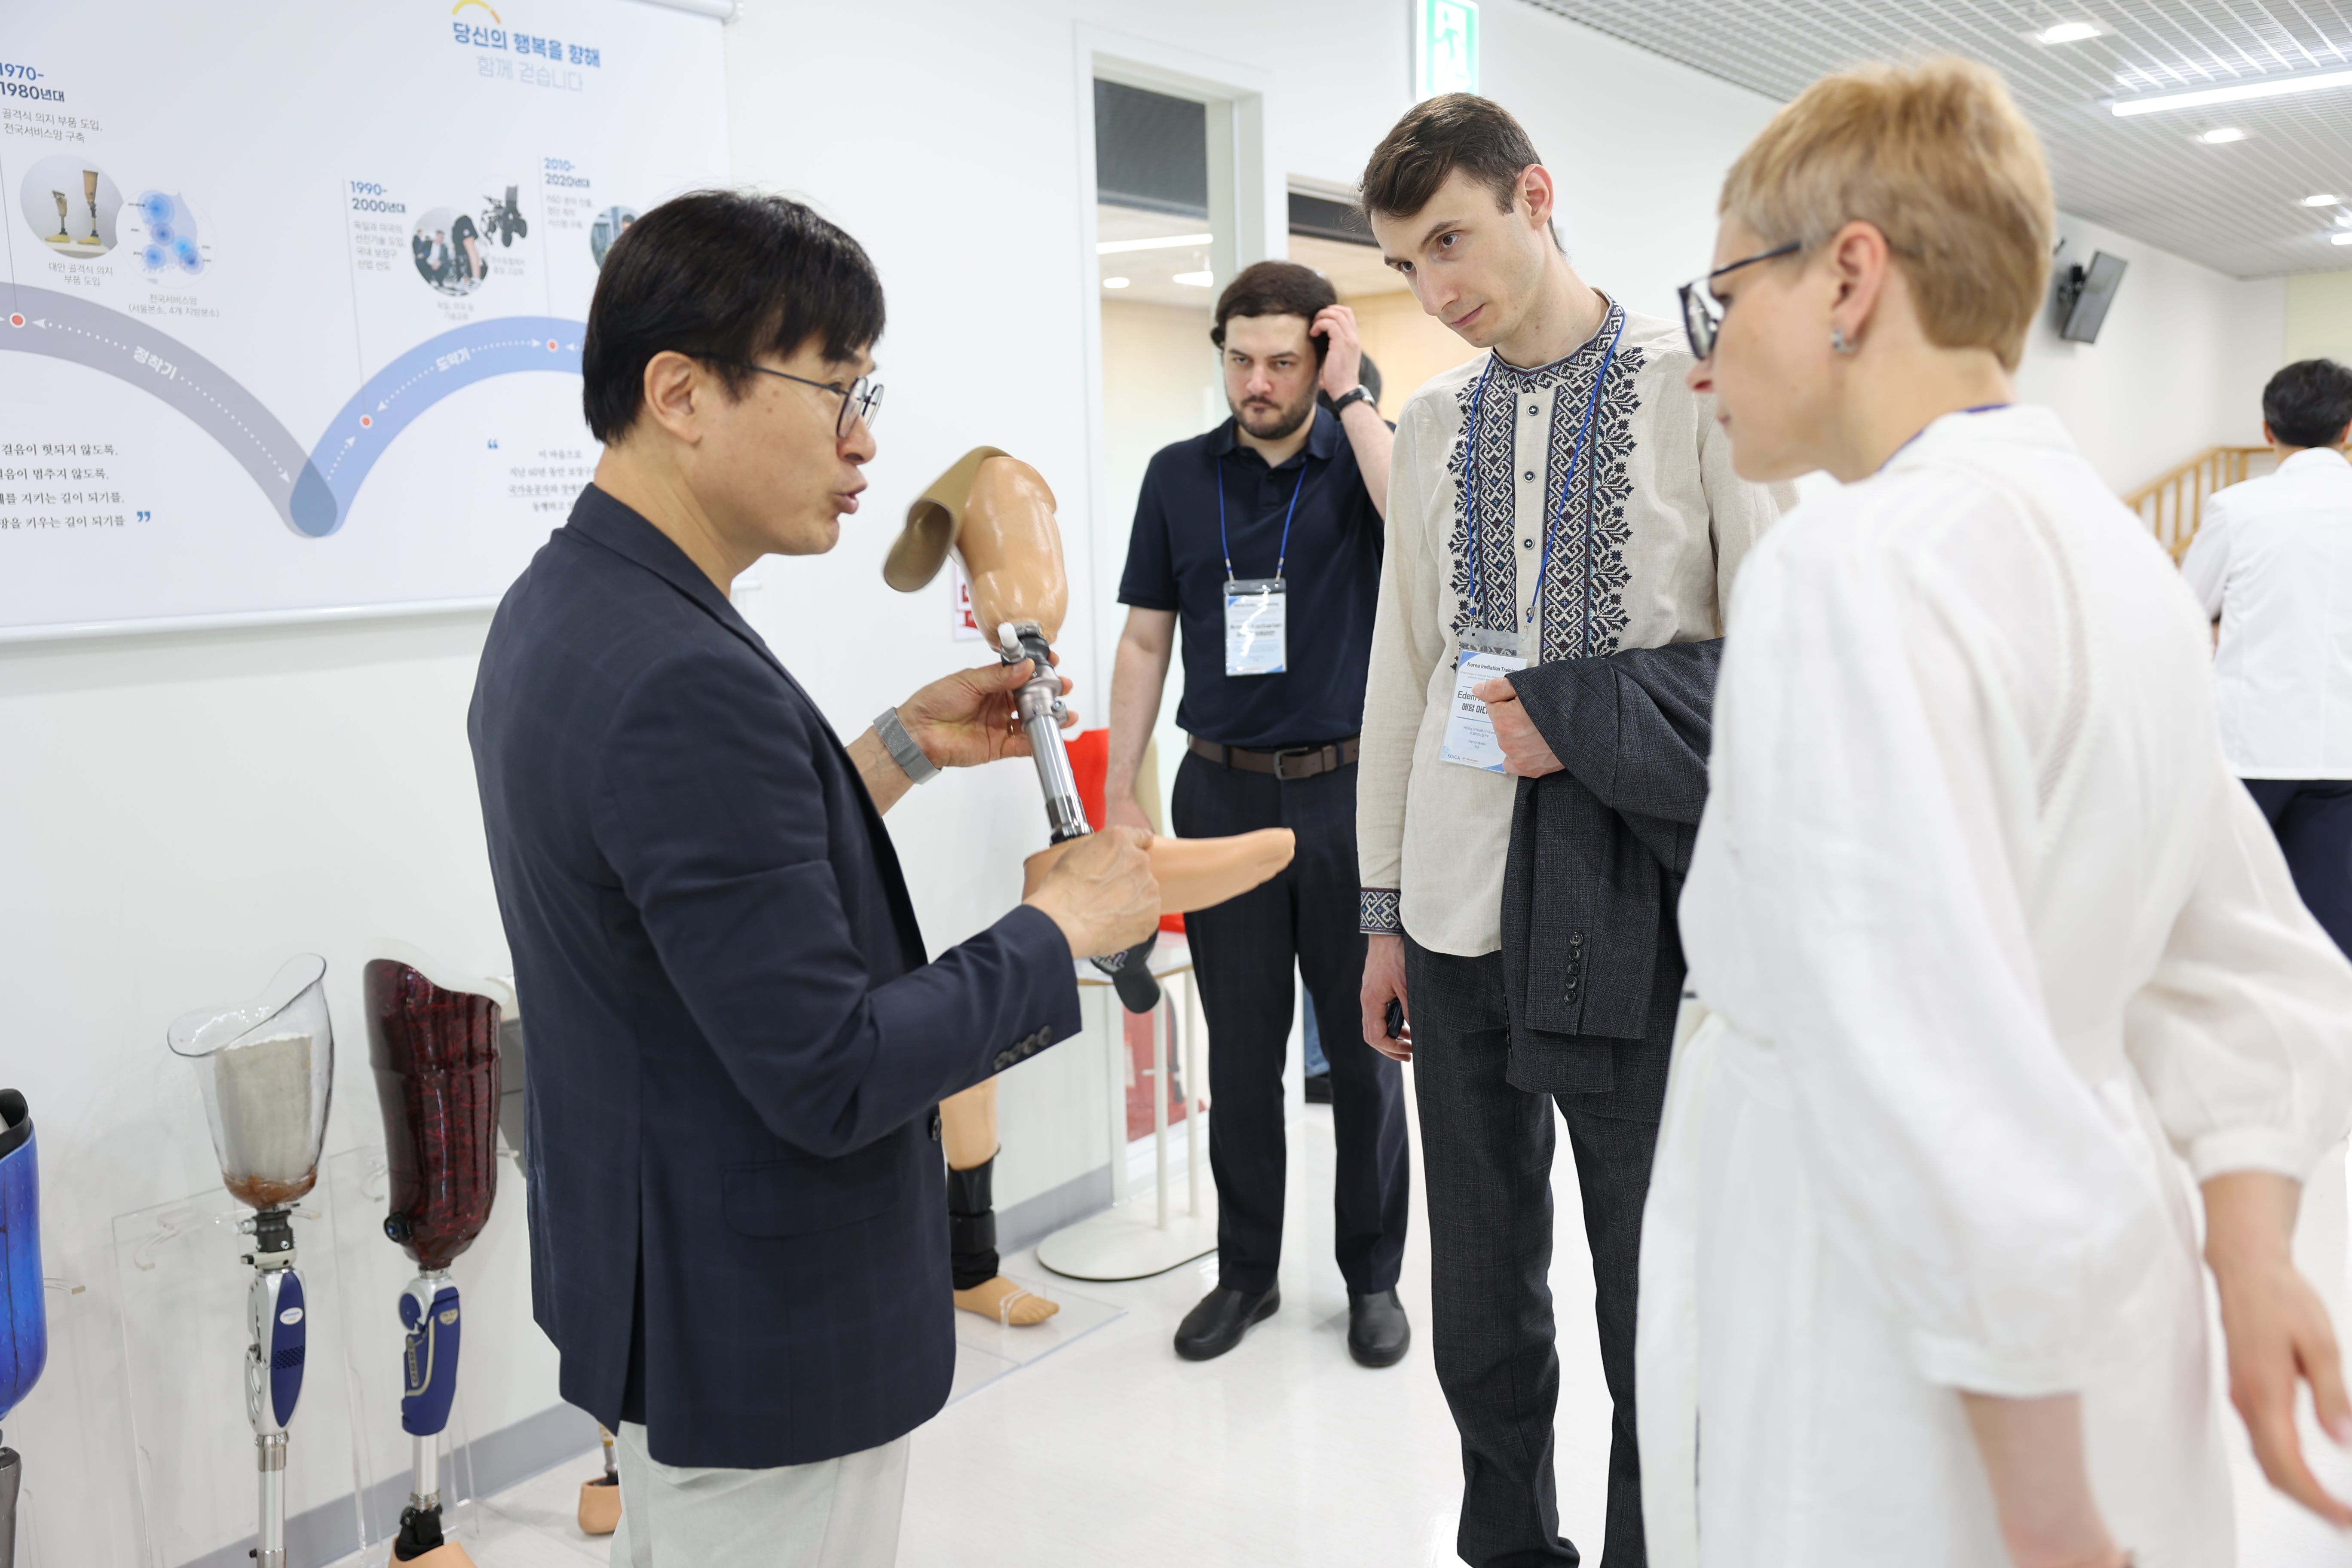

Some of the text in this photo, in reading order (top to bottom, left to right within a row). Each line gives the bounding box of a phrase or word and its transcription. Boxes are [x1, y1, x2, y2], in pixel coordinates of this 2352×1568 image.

[453, 22, 600, 67] 당신의 행복을 향해
[0, 62, 44, 81] 1970-
[476, 55, 584, 92] 함께 걷습니다
[0, 81, 65, 102] 1980년대
[2, 107, 102, 132] 골격식 의지 부품 도입,
[4, 122, 85, 143] 전국서비스망 구축
[350, 181, 387, 196] 1990-
[352, 197, 406, 214] 2000년대
[49, 262, 113, 276] 대만 골격식 의지
[64, 274, 100, 287] 부품 도입
[149, 293, 198, 306] 전국서비스망
[133, 345, 178, 380] 정착기
[2, 443, 118, 456] 걸음이 헛되지 않도록,
[33, 468, 67, 481] 멈추지
[71, 467, 109, 480] 않도록,
[21, 492, 56, 505] 지키는
[61, 492, 83, 504] 길이
[88, 491, 124, 504] 되기를,
[26, 516, 61, 529] 키우는
[65, 515, 87, 528] 길이
[92, 515, 125, 527] 되기를
[1458, 690, 1477, 701] Edem
[1462, 703, 1475, 712] 에덤
